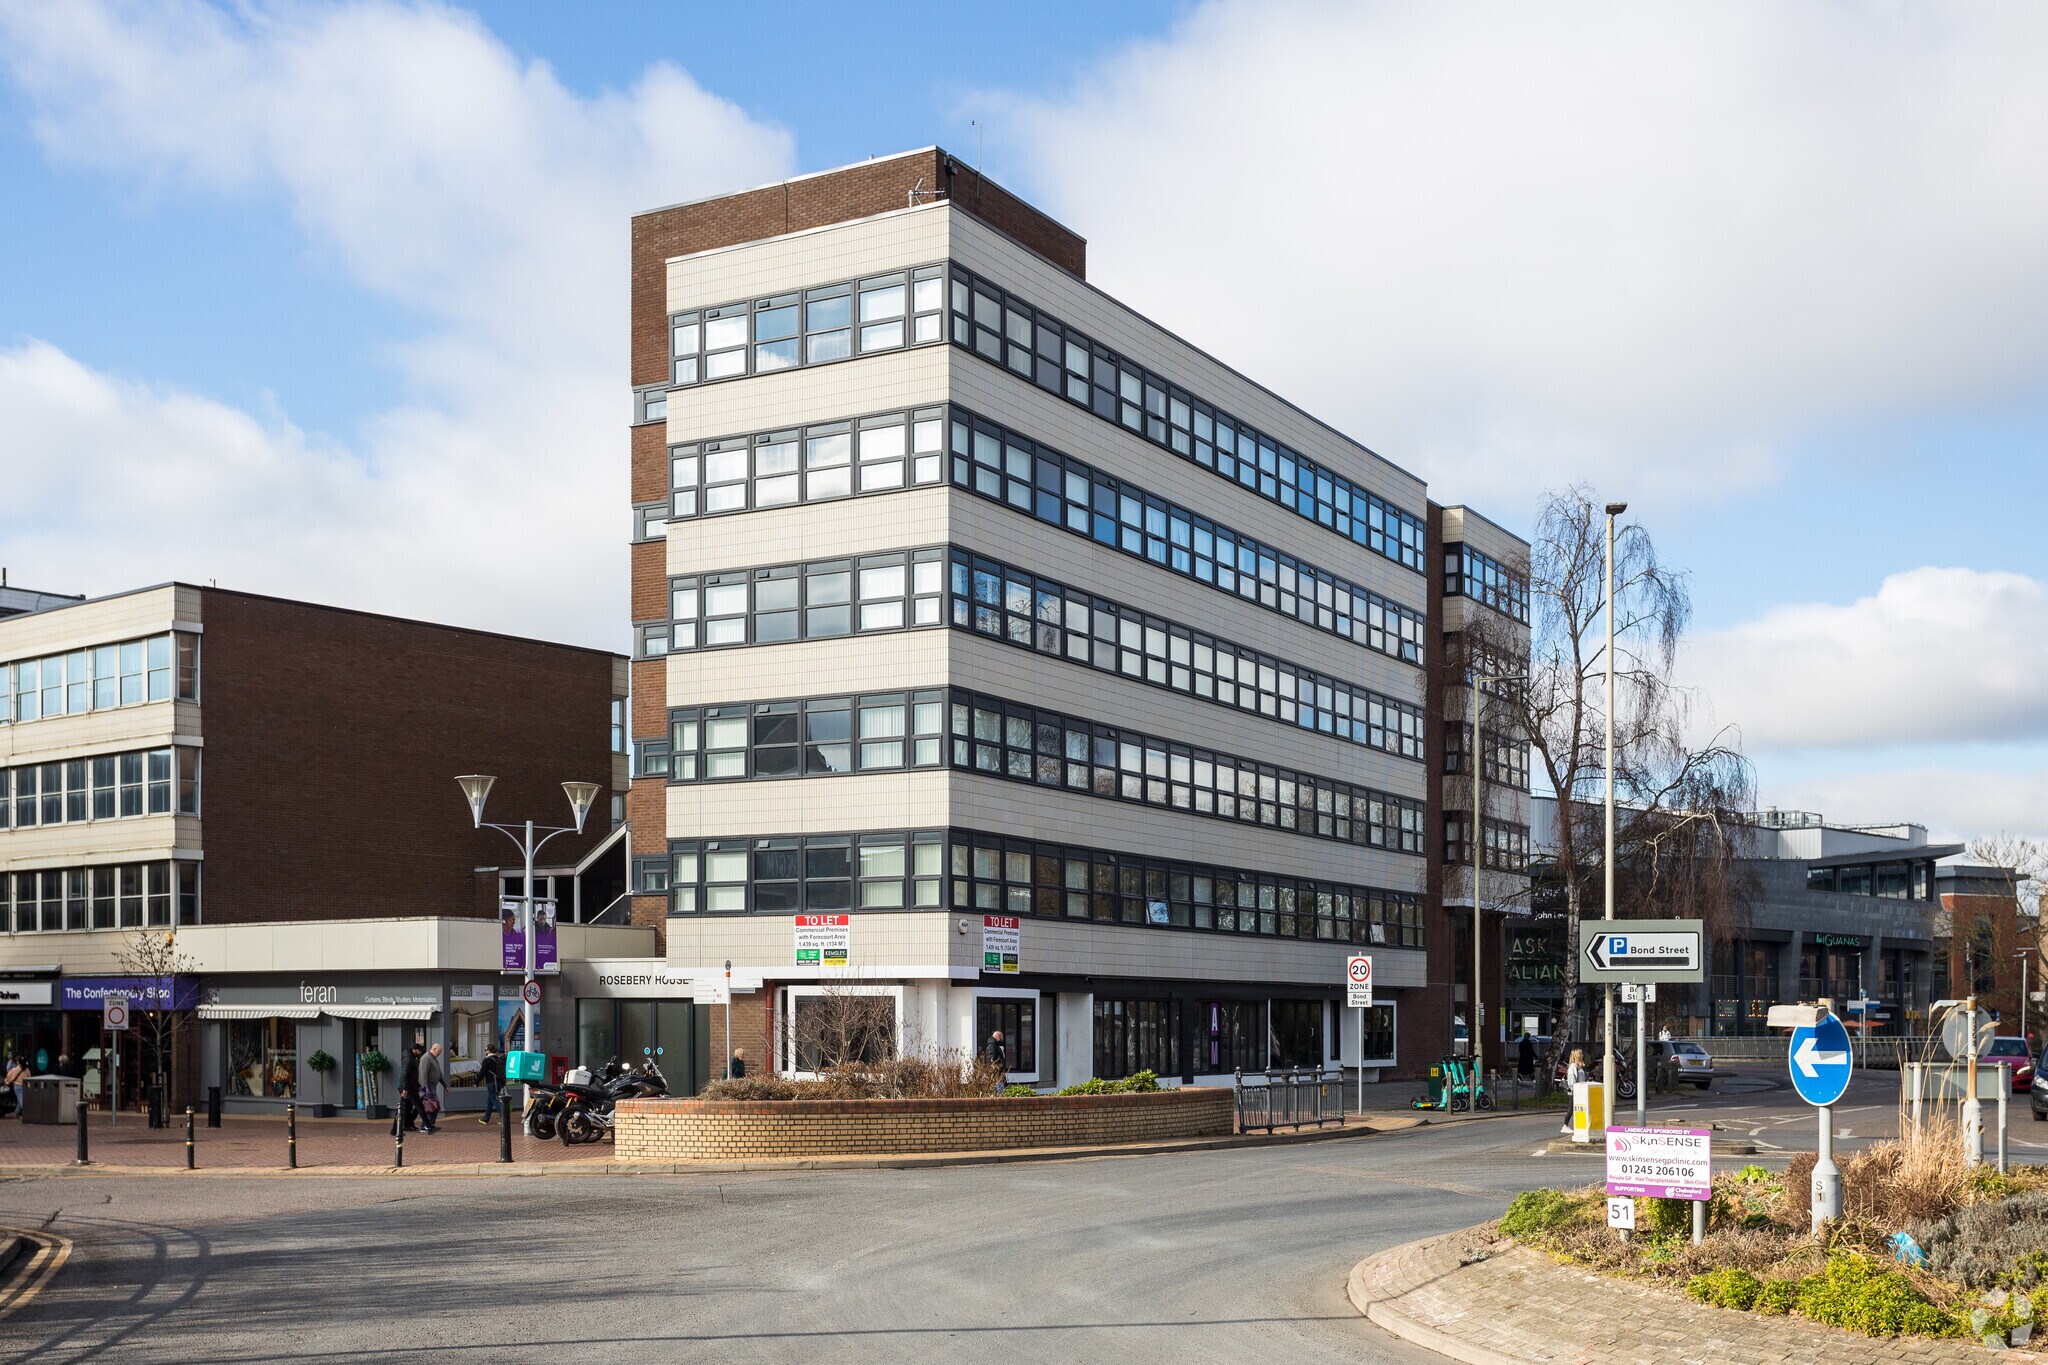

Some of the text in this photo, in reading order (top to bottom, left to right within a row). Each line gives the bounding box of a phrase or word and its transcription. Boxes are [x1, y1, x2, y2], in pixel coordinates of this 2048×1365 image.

[804, 915, 839, 925] TO LET
[990, 916, 1013, 928] TO LET
[1512, 938, 1548, 954] ASK
[1614, 939, 1625, 953] P
[1352, 965, 1367, 975] 20
[1509, 964, 1568, 980] ALIAN
[600, 976, 652, 985] ROSEBERY
[66, 988, 82, 998] The
[300, 980, 337, 1002] feran
[452, 986, 472, 996] feran
[500, 986, 518, 996] feran
[1609, 1155, 1708, 1166] www.skinsensegpclinic.com
[1622, 1164, 1694, 1177] 01245 206106
[1816, 1181, 1823, 1190] S
[1818, 1193, 1822, 1201] 1
[1612, 1205, 1629, 1220] 51
